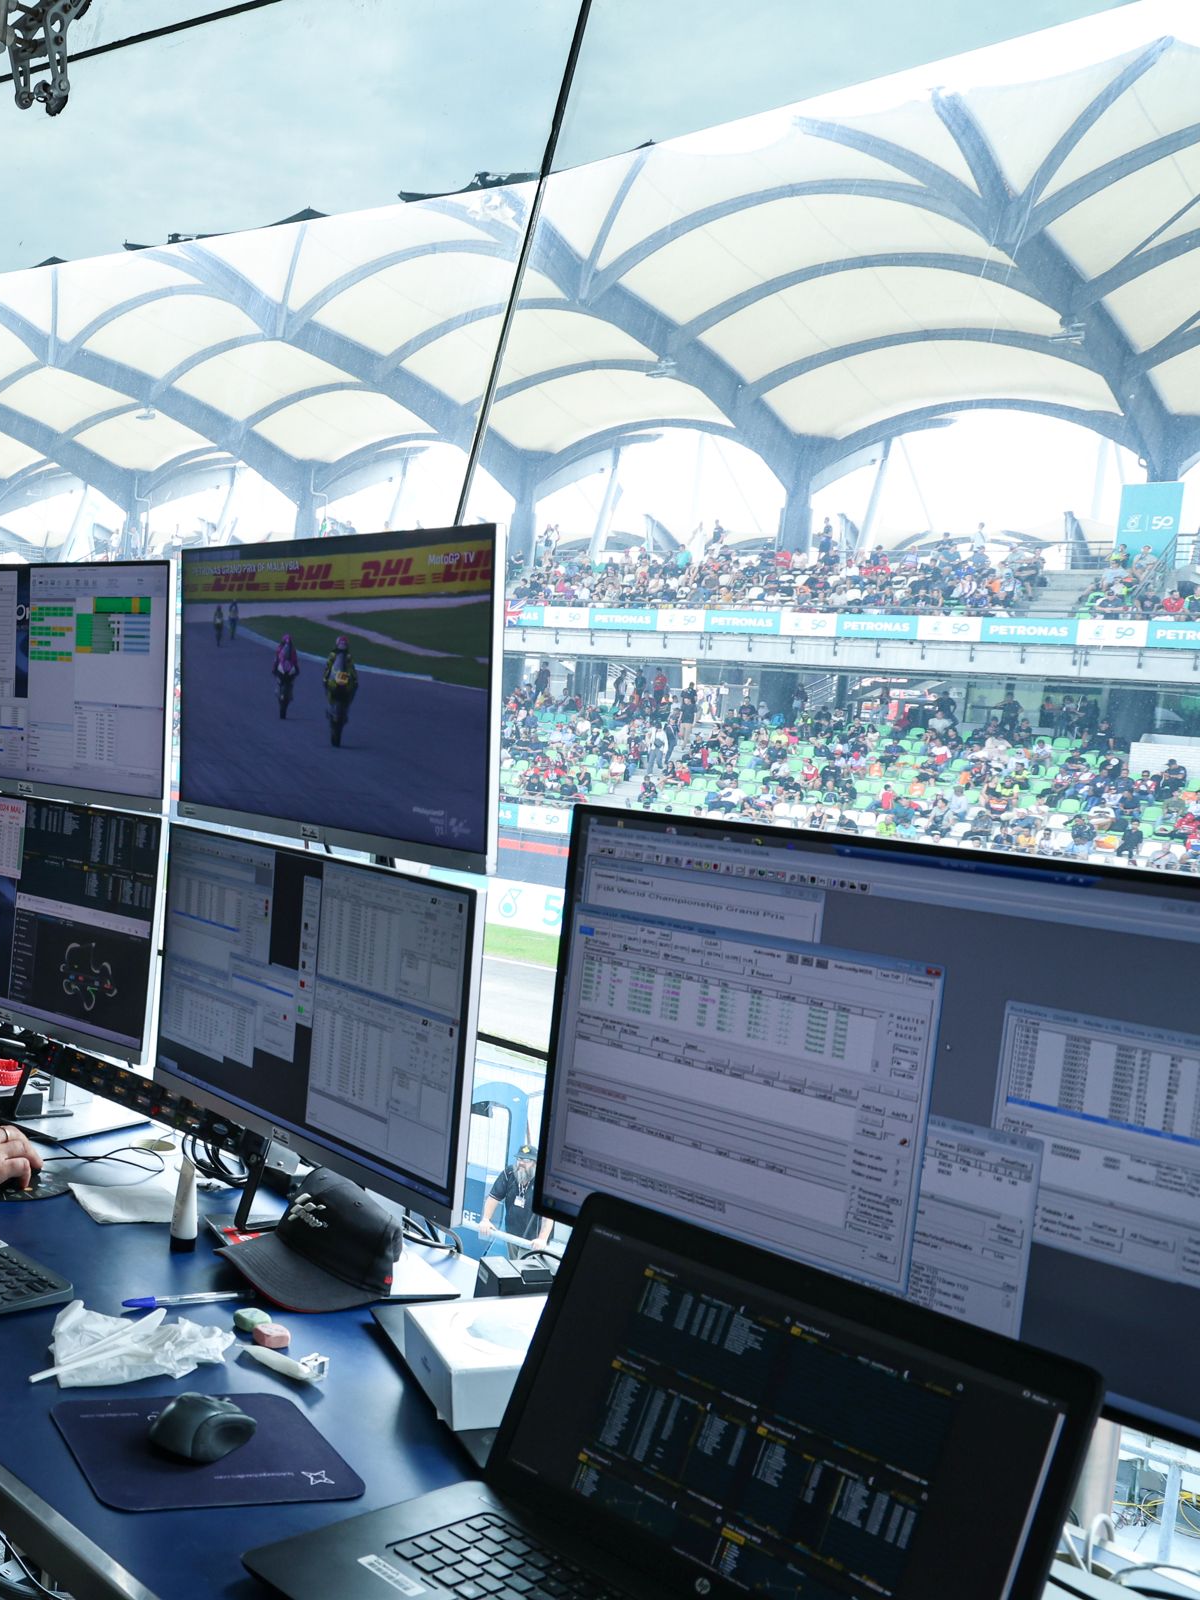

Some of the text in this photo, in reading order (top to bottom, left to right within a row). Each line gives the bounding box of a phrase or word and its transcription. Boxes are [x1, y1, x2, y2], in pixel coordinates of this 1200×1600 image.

[428, 552, 475, 566] MotoGP TV
[266, 561, 299, 571] MALAYSIA
[360, 557, 416, 588] DHL
[286, 563, 340, 592] DHL
[594, 614, 651, 625] PETRONAS
[710, 616, 773, 628] PETRONAS
[842, 621, 910, 633] PETRONAS
[989, 625, 1069, 638] PETRONAS
[616, 887, 646, 899] World
[648, 893, 724, 912] Championship
[726, 904, 760, 917] Grand
[762, 910, 785, 921] Prix
